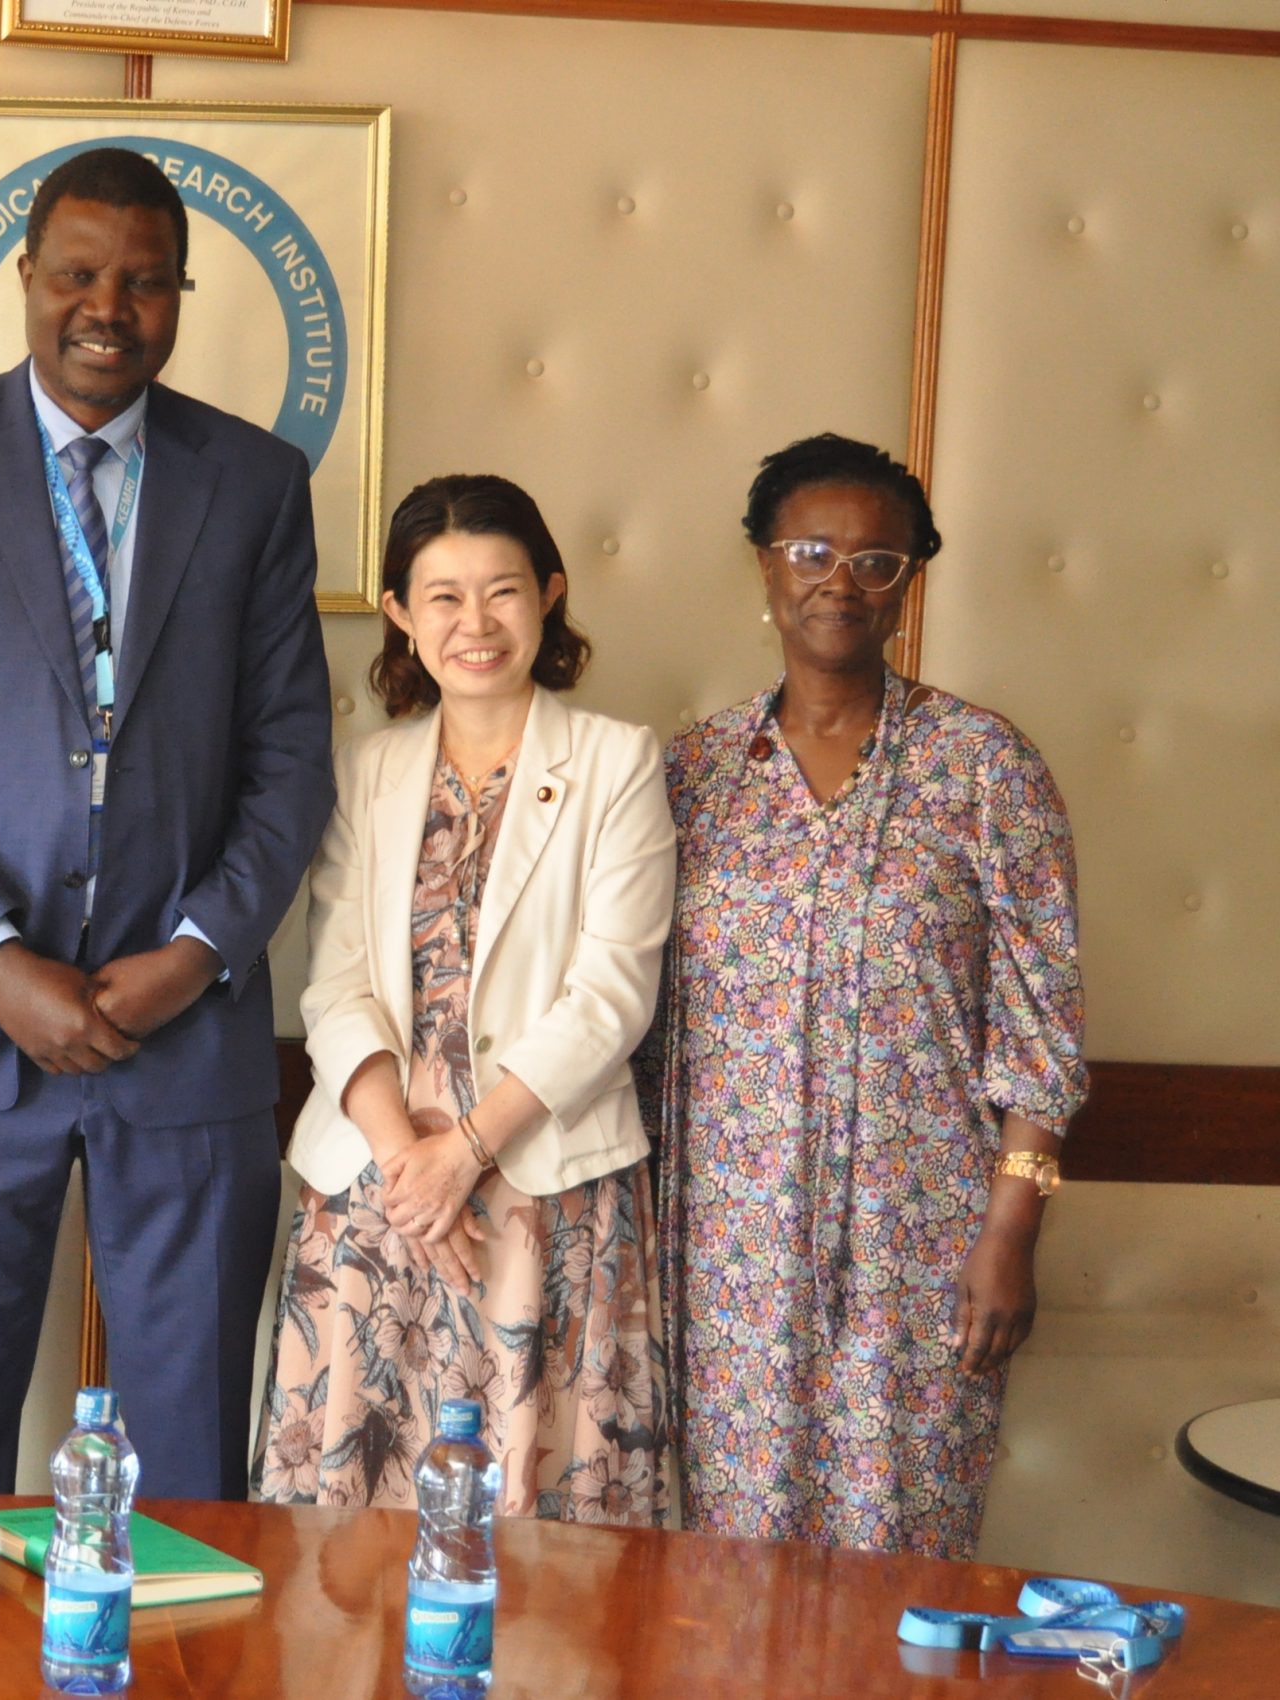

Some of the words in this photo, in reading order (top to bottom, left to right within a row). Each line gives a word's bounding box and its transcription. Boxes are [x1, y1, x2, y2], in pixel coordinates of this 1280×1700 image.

[129, 4, 161, 13] Republic
[173, 7, 196, 17] Kenya
[163, 17, 193, 26] Defence
[195, 19, 220, 28] Forces
[143, 153, 274, 233] EARCH
[271, 234, 332, 416] INSTITUTE
[116, 477, 136, 526] KEMRI
